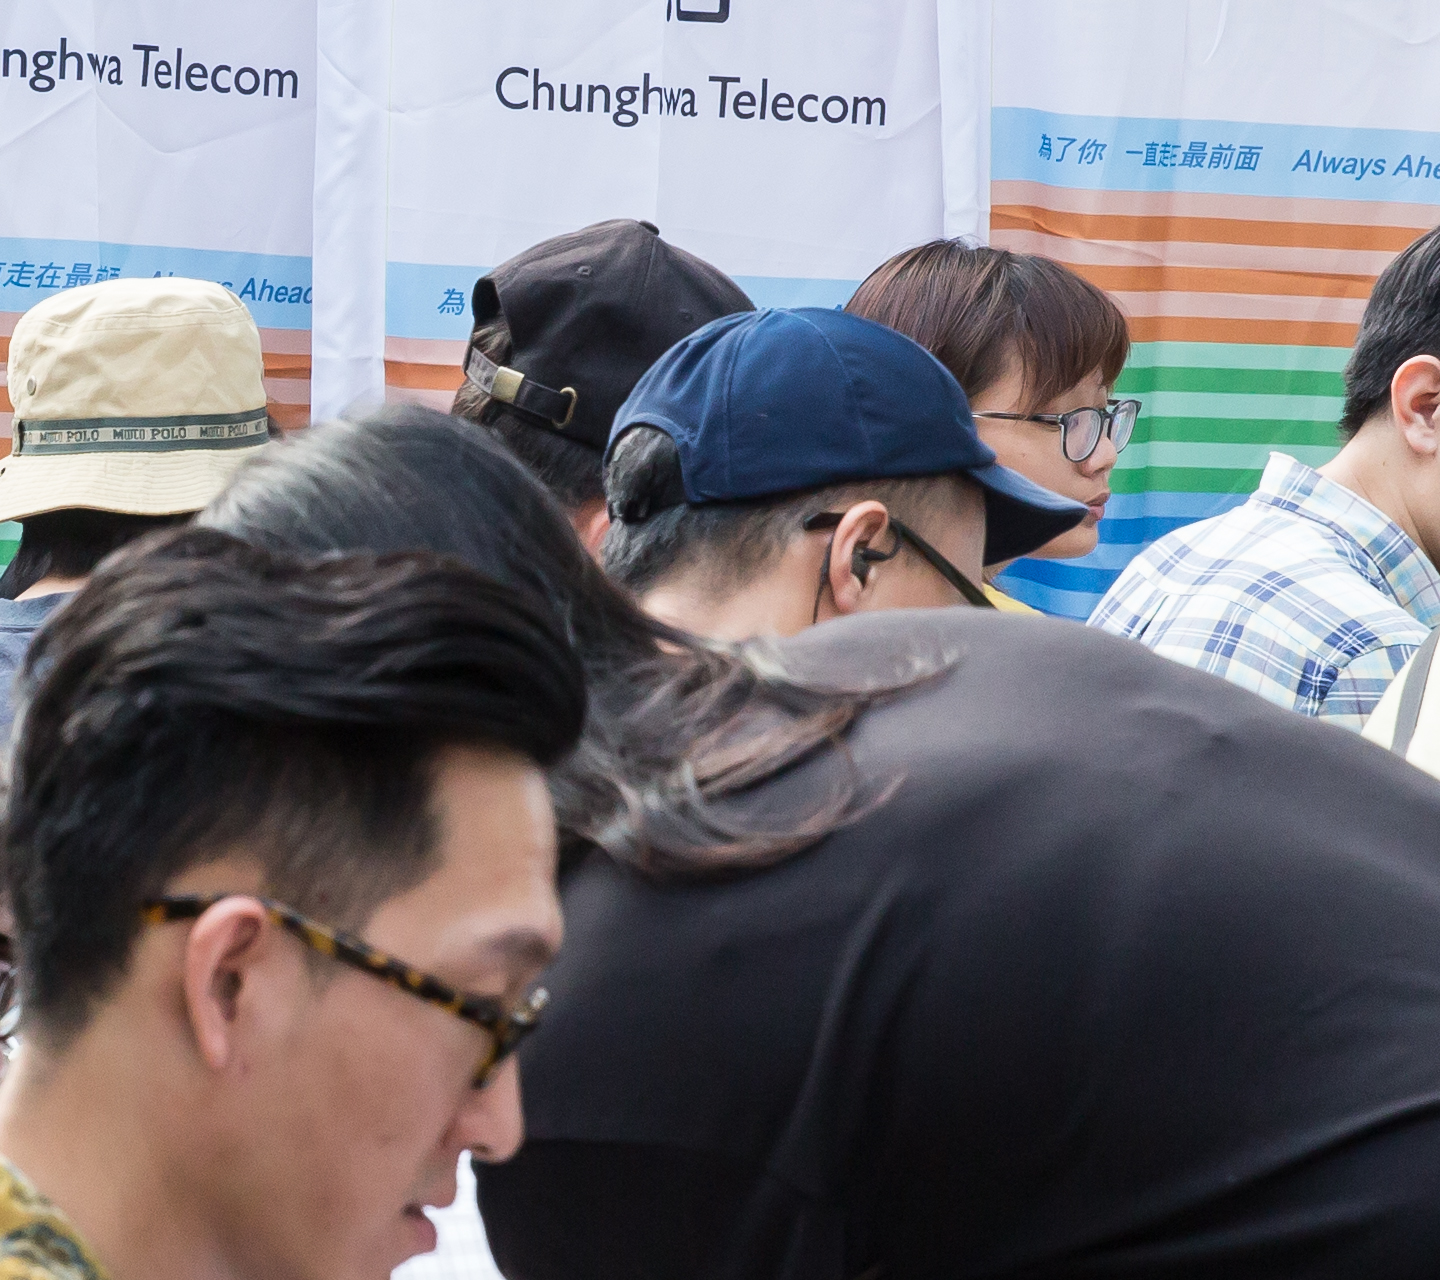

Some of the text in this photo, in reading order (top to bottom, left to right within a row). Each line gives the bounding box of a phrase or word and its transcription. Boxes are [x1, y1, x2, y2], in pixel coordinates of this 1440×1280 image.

[133, 44, 298, 98] Telecom
[496, 67, 885, 127] Chunghwa Telecom
[1038, 133, 1107, 165] 為了你
[1291, 150, 1386, 180] Always
[150, 426, 187, 440] POLO
